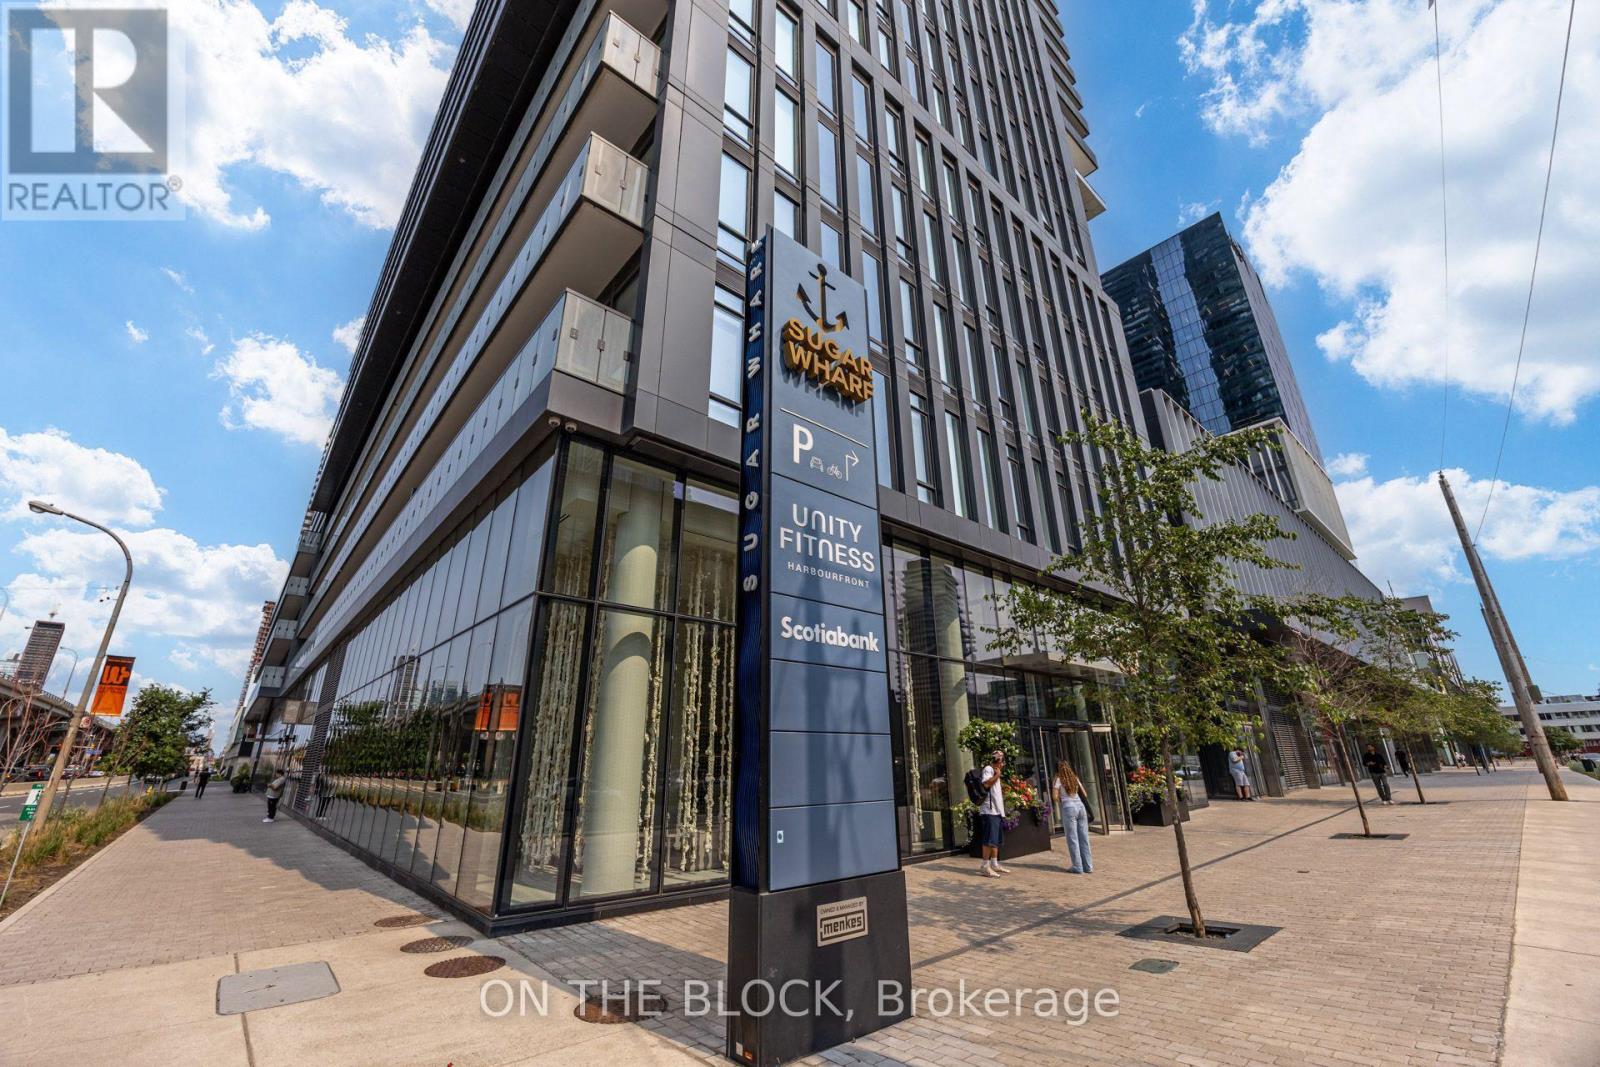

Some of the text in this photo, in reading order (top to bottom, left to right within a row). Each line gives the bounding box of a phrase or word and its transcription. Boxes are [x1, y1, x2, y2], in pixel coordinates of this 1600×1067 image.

[786, 317, 874, 378] SUGAR
[786, 340, 875, 400] WHARF
[792, 423, 814, 464] P
[743, 412, 760, 593] SUGAR
[792, 503, 862, 543] UNITY
[779, 526, 875, 573] FITNESS
[787, 561, 870, 589] HARBOURFRONT
[780, 615, 880, 653] Scotiabank
[824, 916, 862, 935] menkes
